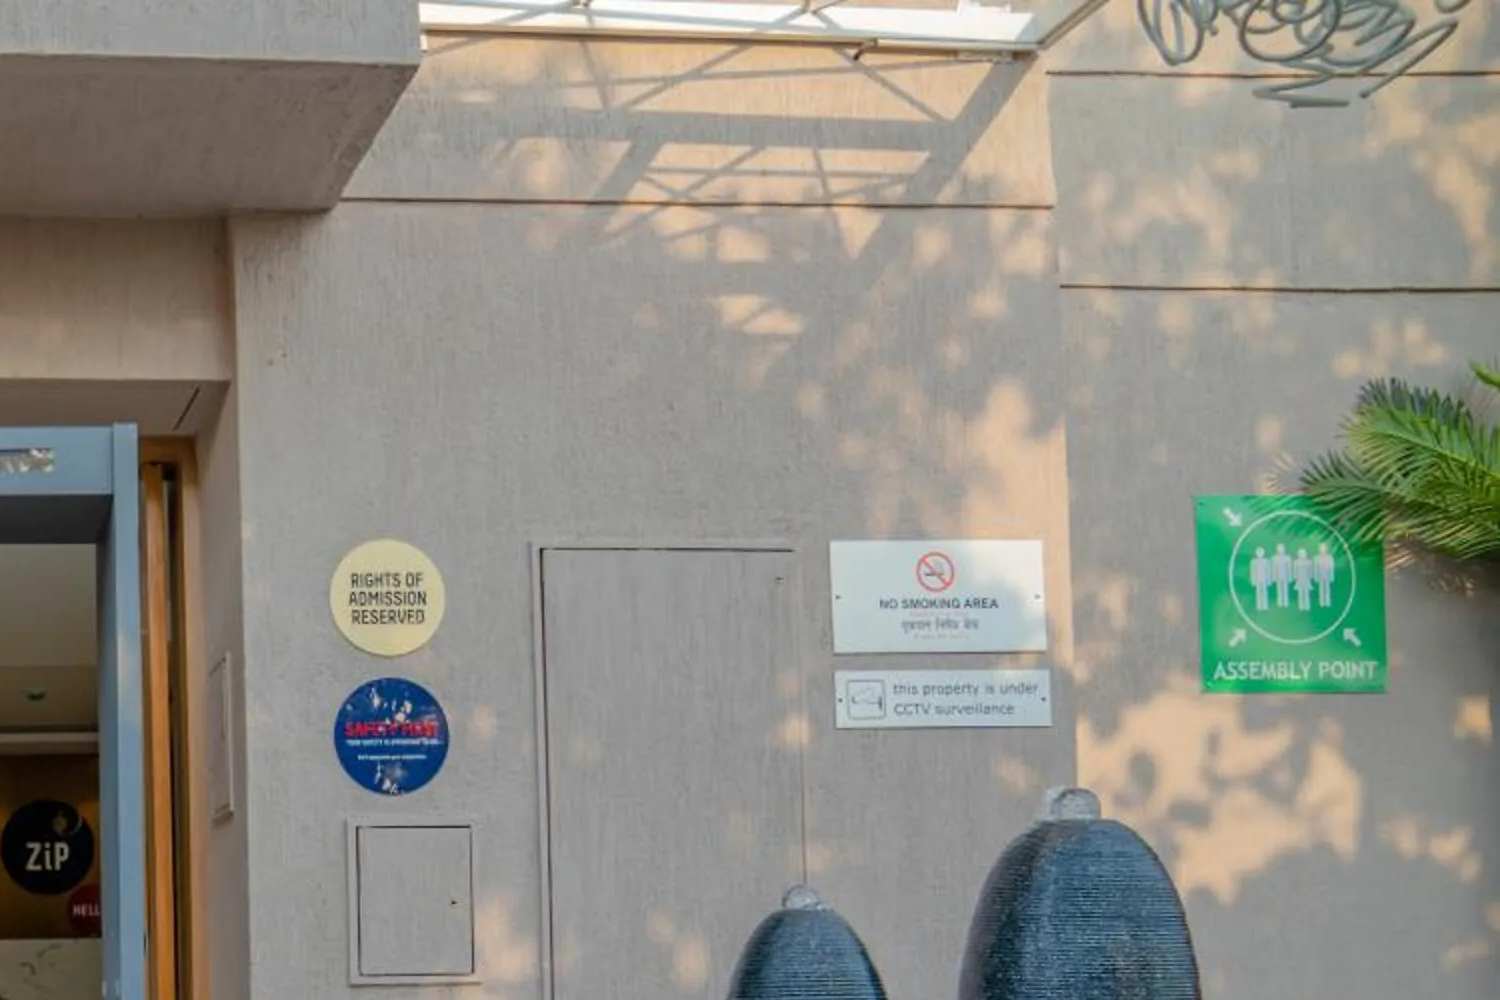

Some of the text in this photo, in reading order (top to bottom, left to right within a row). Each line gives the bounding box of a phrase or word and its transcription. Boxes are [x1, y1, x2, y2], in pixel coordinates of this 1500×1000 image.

[351, 571, 424, 588] RIGHTS OF
[349, 591, 427, 607] ADMISSION
[879, 597, 999, 609] NO SMOKING AREA
[351, 609, 425, 625] RESERVED
[1213, 660, 1380, 680] ASSEMBLY POINT
[893, 682, 1039, 697] this property is under
[893, 702, 1015, 716] CCTV surveillance
[73, 903, 101, 918] HELL
